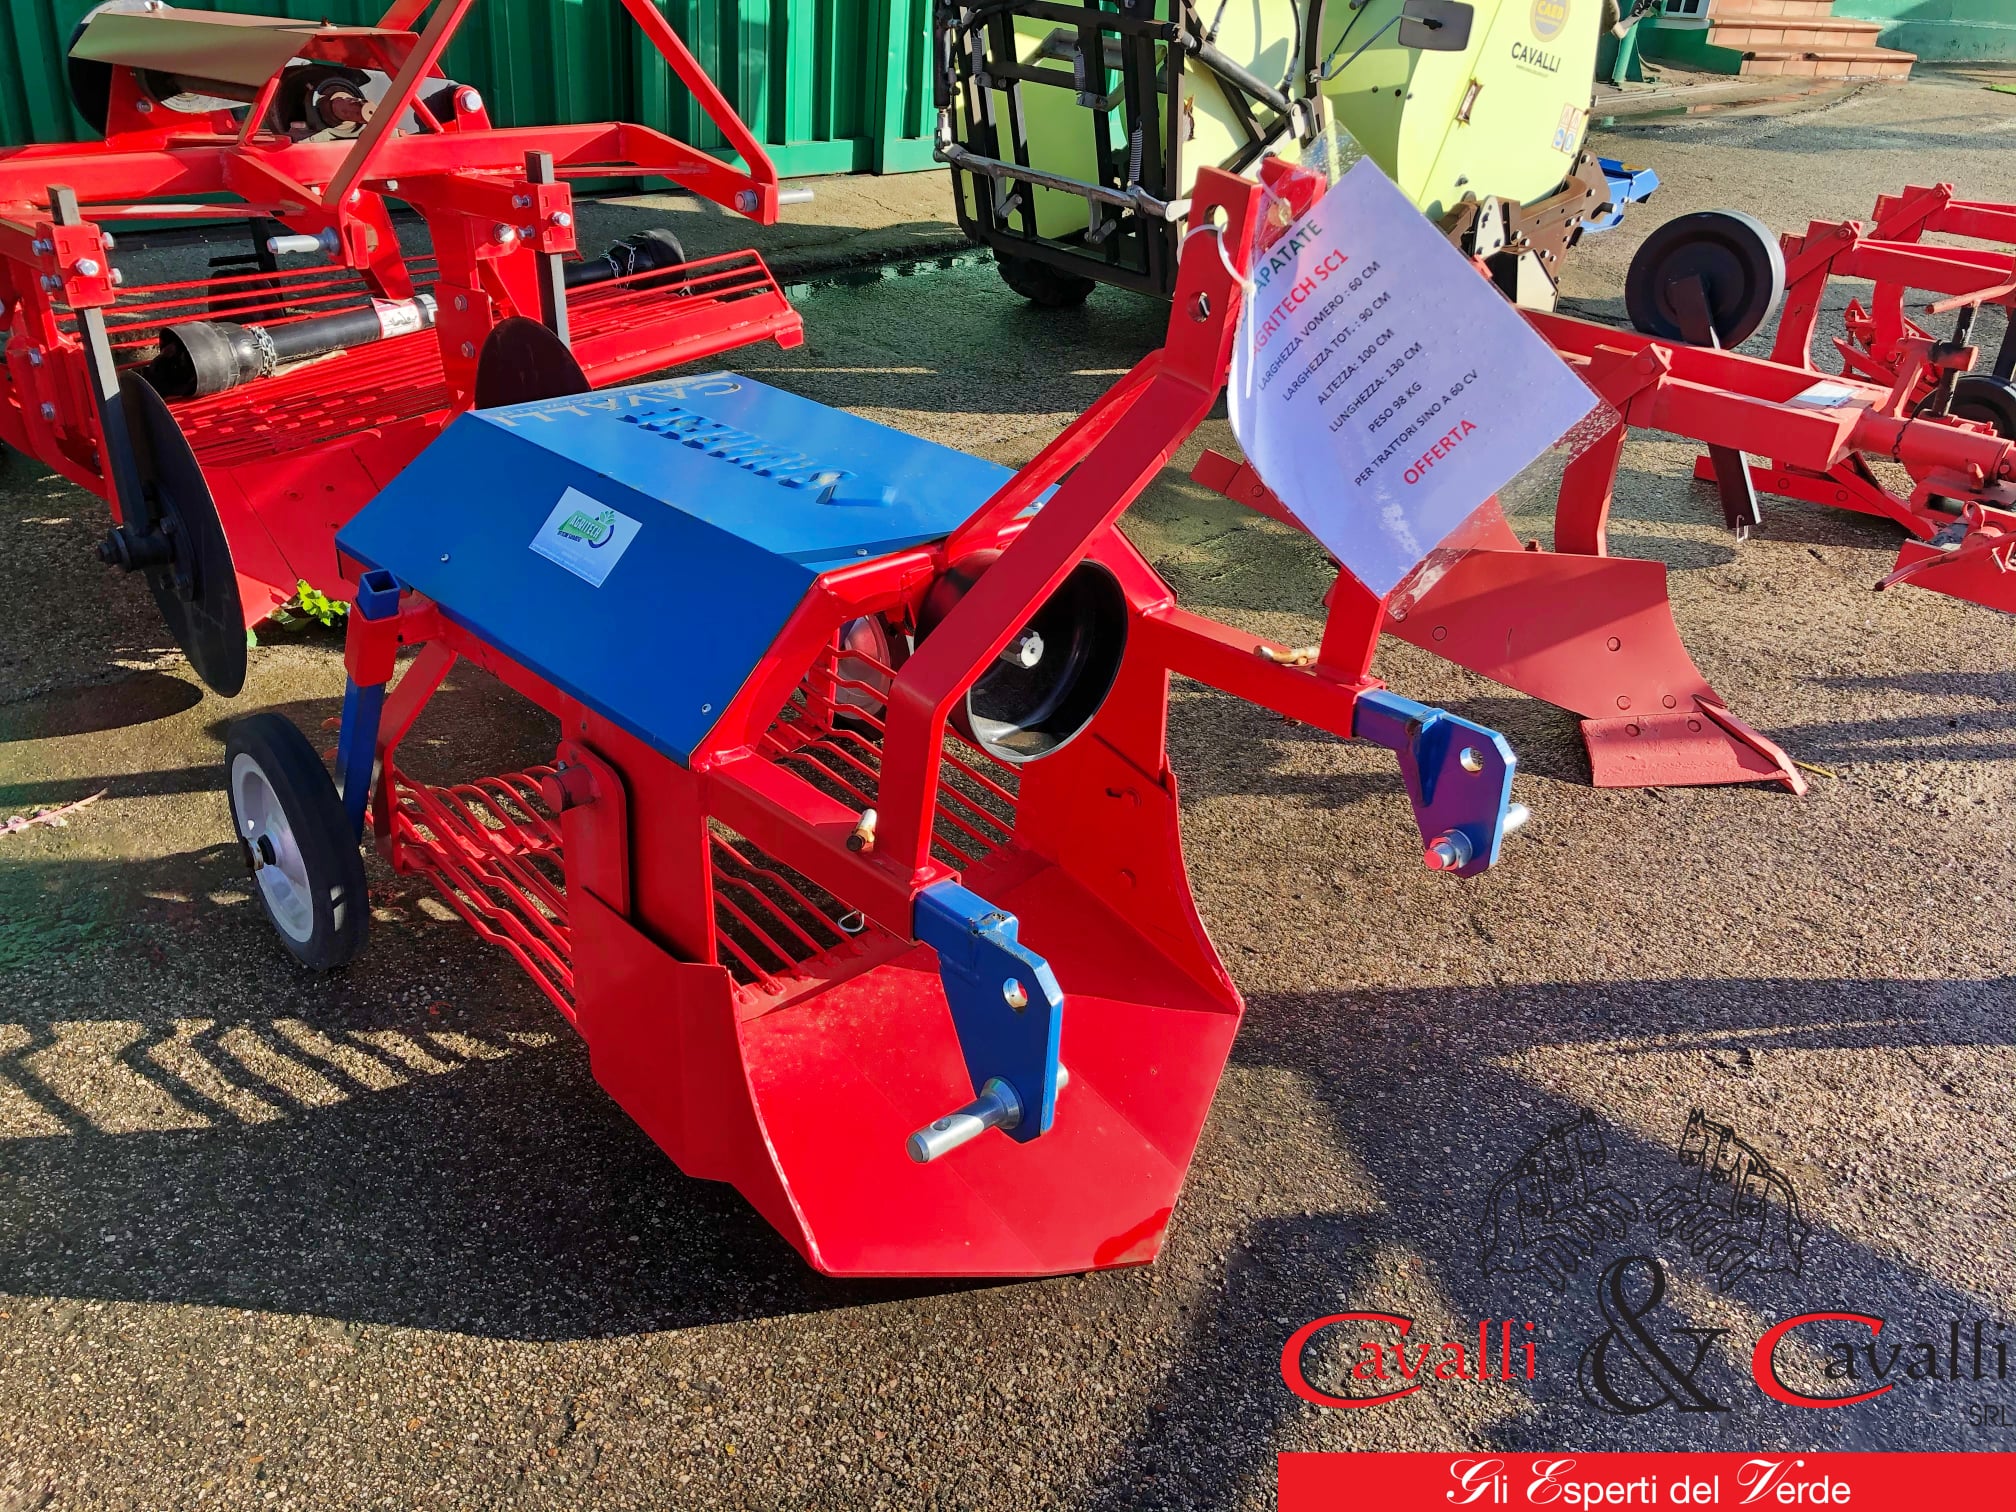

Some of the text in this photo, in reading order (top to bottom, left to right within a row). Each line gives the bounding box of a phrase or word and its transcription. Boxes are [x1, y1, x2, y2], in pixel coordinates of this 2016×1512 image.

[1511, 42, 1562, 73] CAVALLI
[1252, 219, 1323, 296] APATATE
[1314, 249, 1349, 281] SC1
[1258, 337, 1303, 391] LARGHEZZA
[1300, 294, 1344, 337] VOMERO
[1348, 277, 1363, 292] 60
[1362, 261, 1381, 280] CM
[1282, 348, 1334, 402] LARGHEZZA
[1358, 307, 1373, 322] 90
[1372, 291, 1392, 310] CM
[1317, 328, 1395, 406] ALTEZZA: 100 CM
[1329, 341, 1423, 433] LUNGHEZZA: 130 CM
[494, 379, 742, 428] CAVALLI
[1354, 369, 1478, 487] PER TRATTORI SINO A 60 CV
[1368, 381, 1422, 433] PESO 98 KG
[1403, 419, 1477, 485] OFFERTA
[569, 515, 602, 539] AGRITECH
